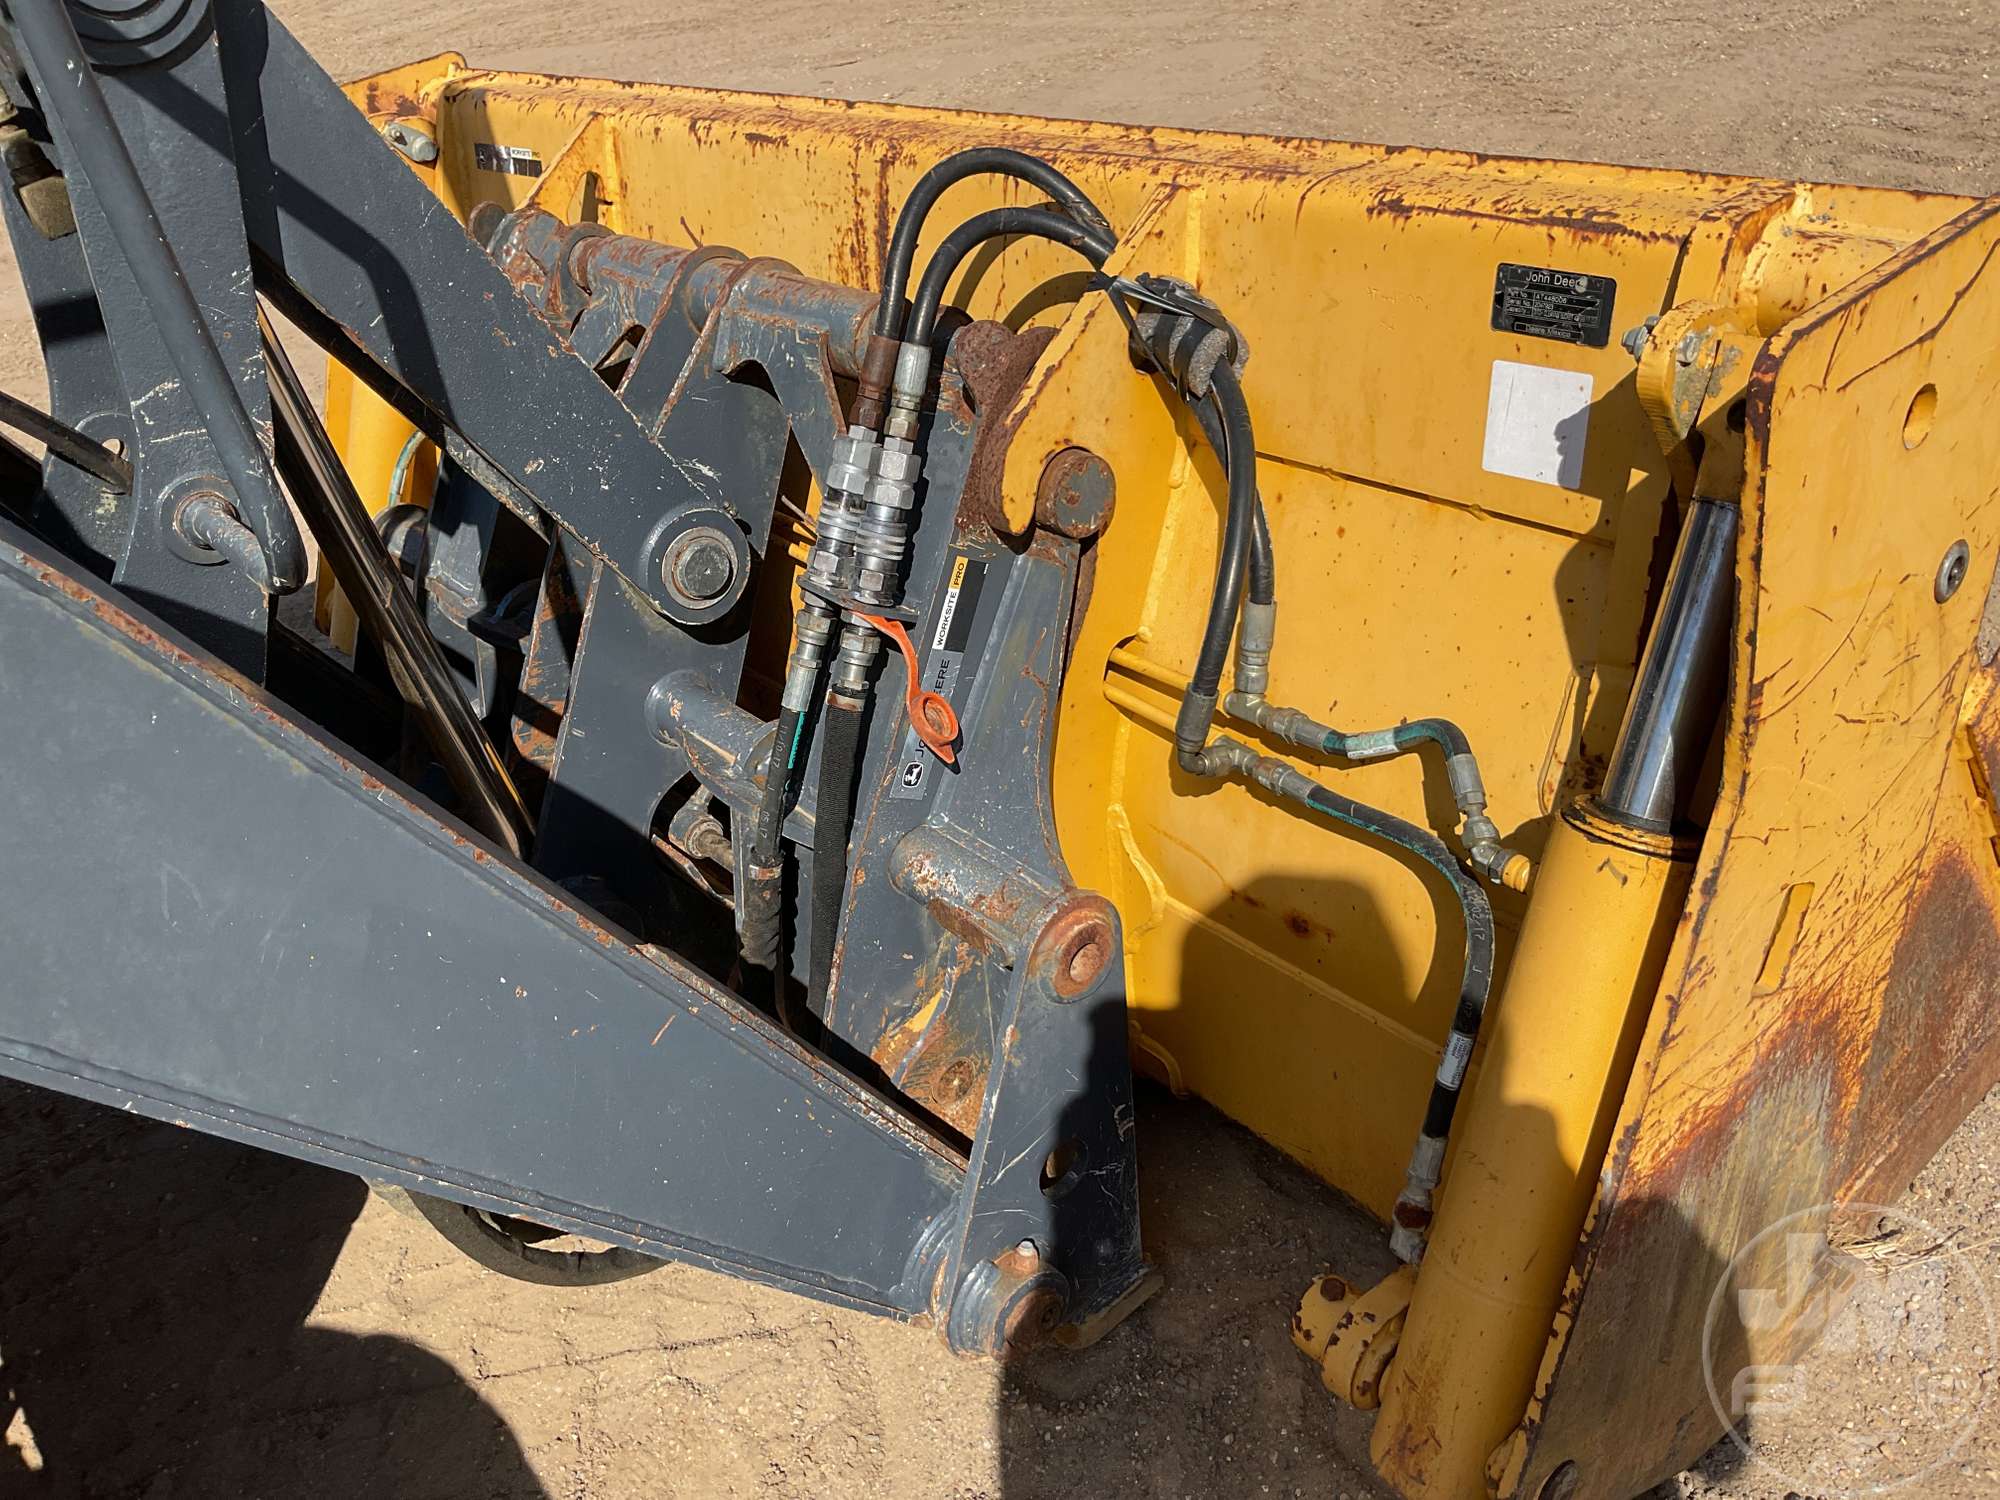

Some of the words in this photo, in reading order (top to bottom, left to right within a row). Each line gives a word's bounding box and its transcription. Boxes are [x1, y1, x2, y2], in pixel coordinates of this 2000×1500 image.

[1525, 271, 1550, 285] John
[936, 591, 957, 646] WORKSITE
[953, 562, 965, 586] PRO
